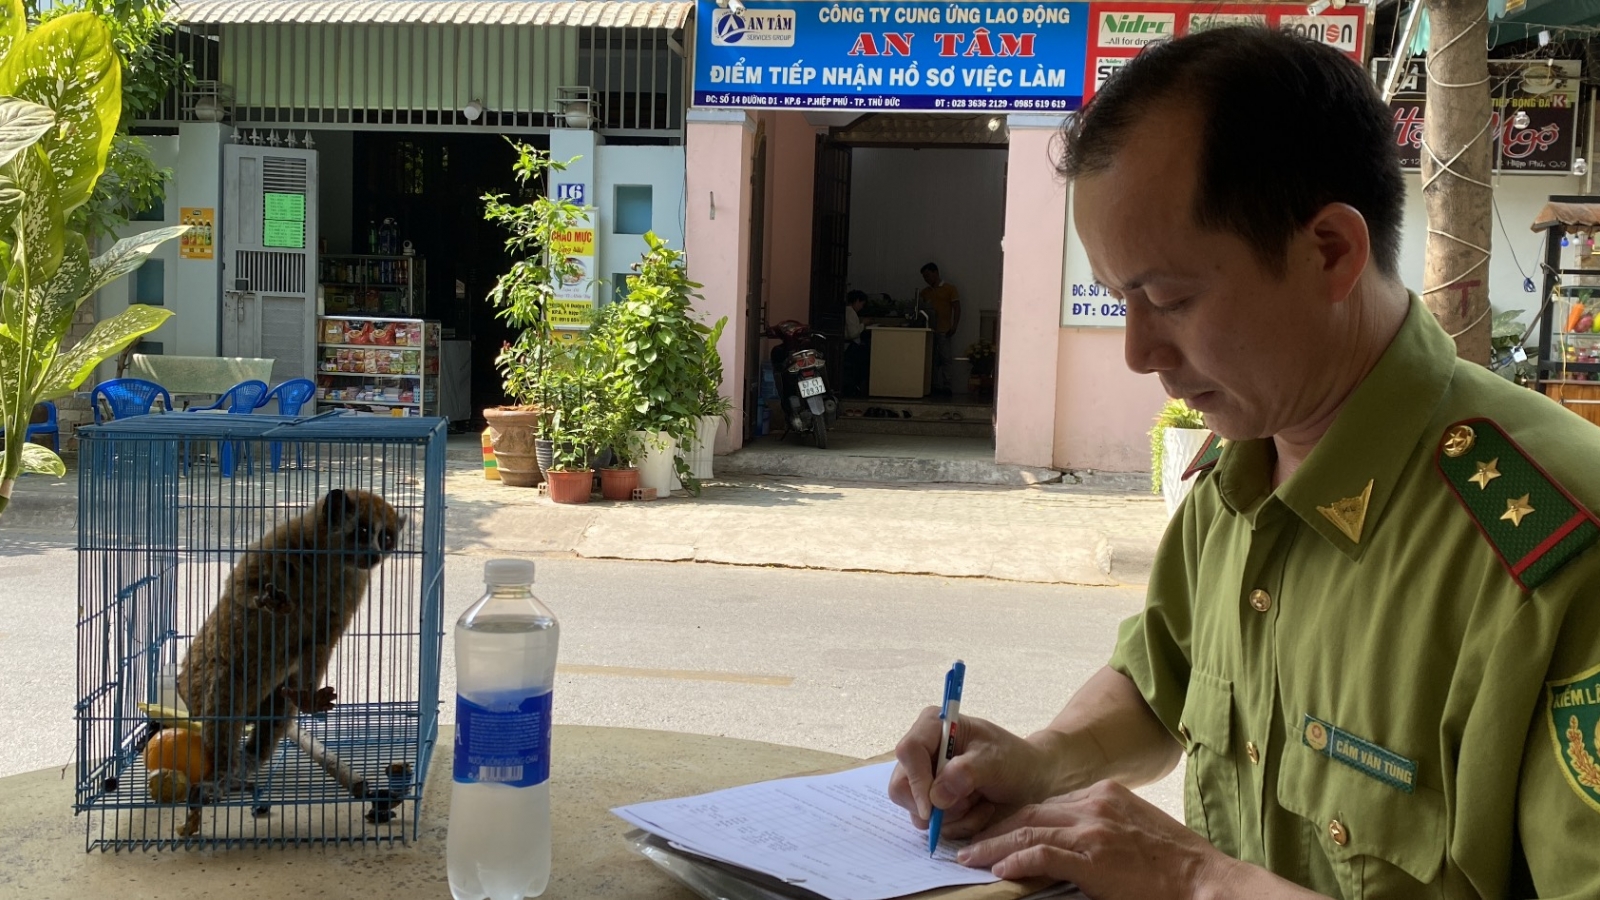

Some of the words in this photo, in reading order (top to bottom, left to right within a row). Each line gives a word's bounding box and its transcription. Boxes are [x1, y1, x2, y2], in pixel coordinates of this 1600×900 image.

[748, 17, 764, 30] AN
[767, 14, 792, 31] TÂM
[819, 4, 864, 23] CÔNG
[869, 8, 891, 23] TY
[895, 8, 940, 24] CUNG
[946, 4, 981, 24] ỨNG
[986, 8, 1018, 24] LAO
[1022, 4, 1070, 28] ĐỘNG
[1102, 14, 1173, 33] Nidec
[847, 32, 915, 56] AN
[934, 27, 1037, 57] TÂM
[1122, 37, 1133, 46] for
[710, 57, 762, 84] ĐIỂM
[769, 59, 817, 85] TIẾP
[822, 63, 882, 91] NHẬN
[890, 61, 920, 87] HỒ
[926, 65, 955, 87] SƠ
[962, 64, 1013, 92] VIỆC
[1019, 64, 1066, 88] LÀM
[719, 93, 730, 104] SỐ
[731, 95, 740, 104] 14
[742, 94, 767, 105] ĐƯỜNG
[784, 96, 801, 105] KP.6
[833, 96, 848, 106] PHÚ
[854, 98, 866, 106] TP.
[868, 96, 882, 107] THỦ
[884, 96, 900, 107] ĐỨC
[952, 99, 966, 108] 028
[968, 99, 986, 108] 3636
[988, 99, 1007, 108] 2129
[1014, 99, 1033, 108] 0985
[1035, 99, 1049, 108] 619
[1052, 99, 1066, 108] 619
[559, 185, 582, 199] 16
[1072, 284, 1086, 296] ĐC:
[1448, 280, 1482, 318] T
[1072, 303, 1096, 316] ĐT:
[1101, 304, 1127, 316] 028
